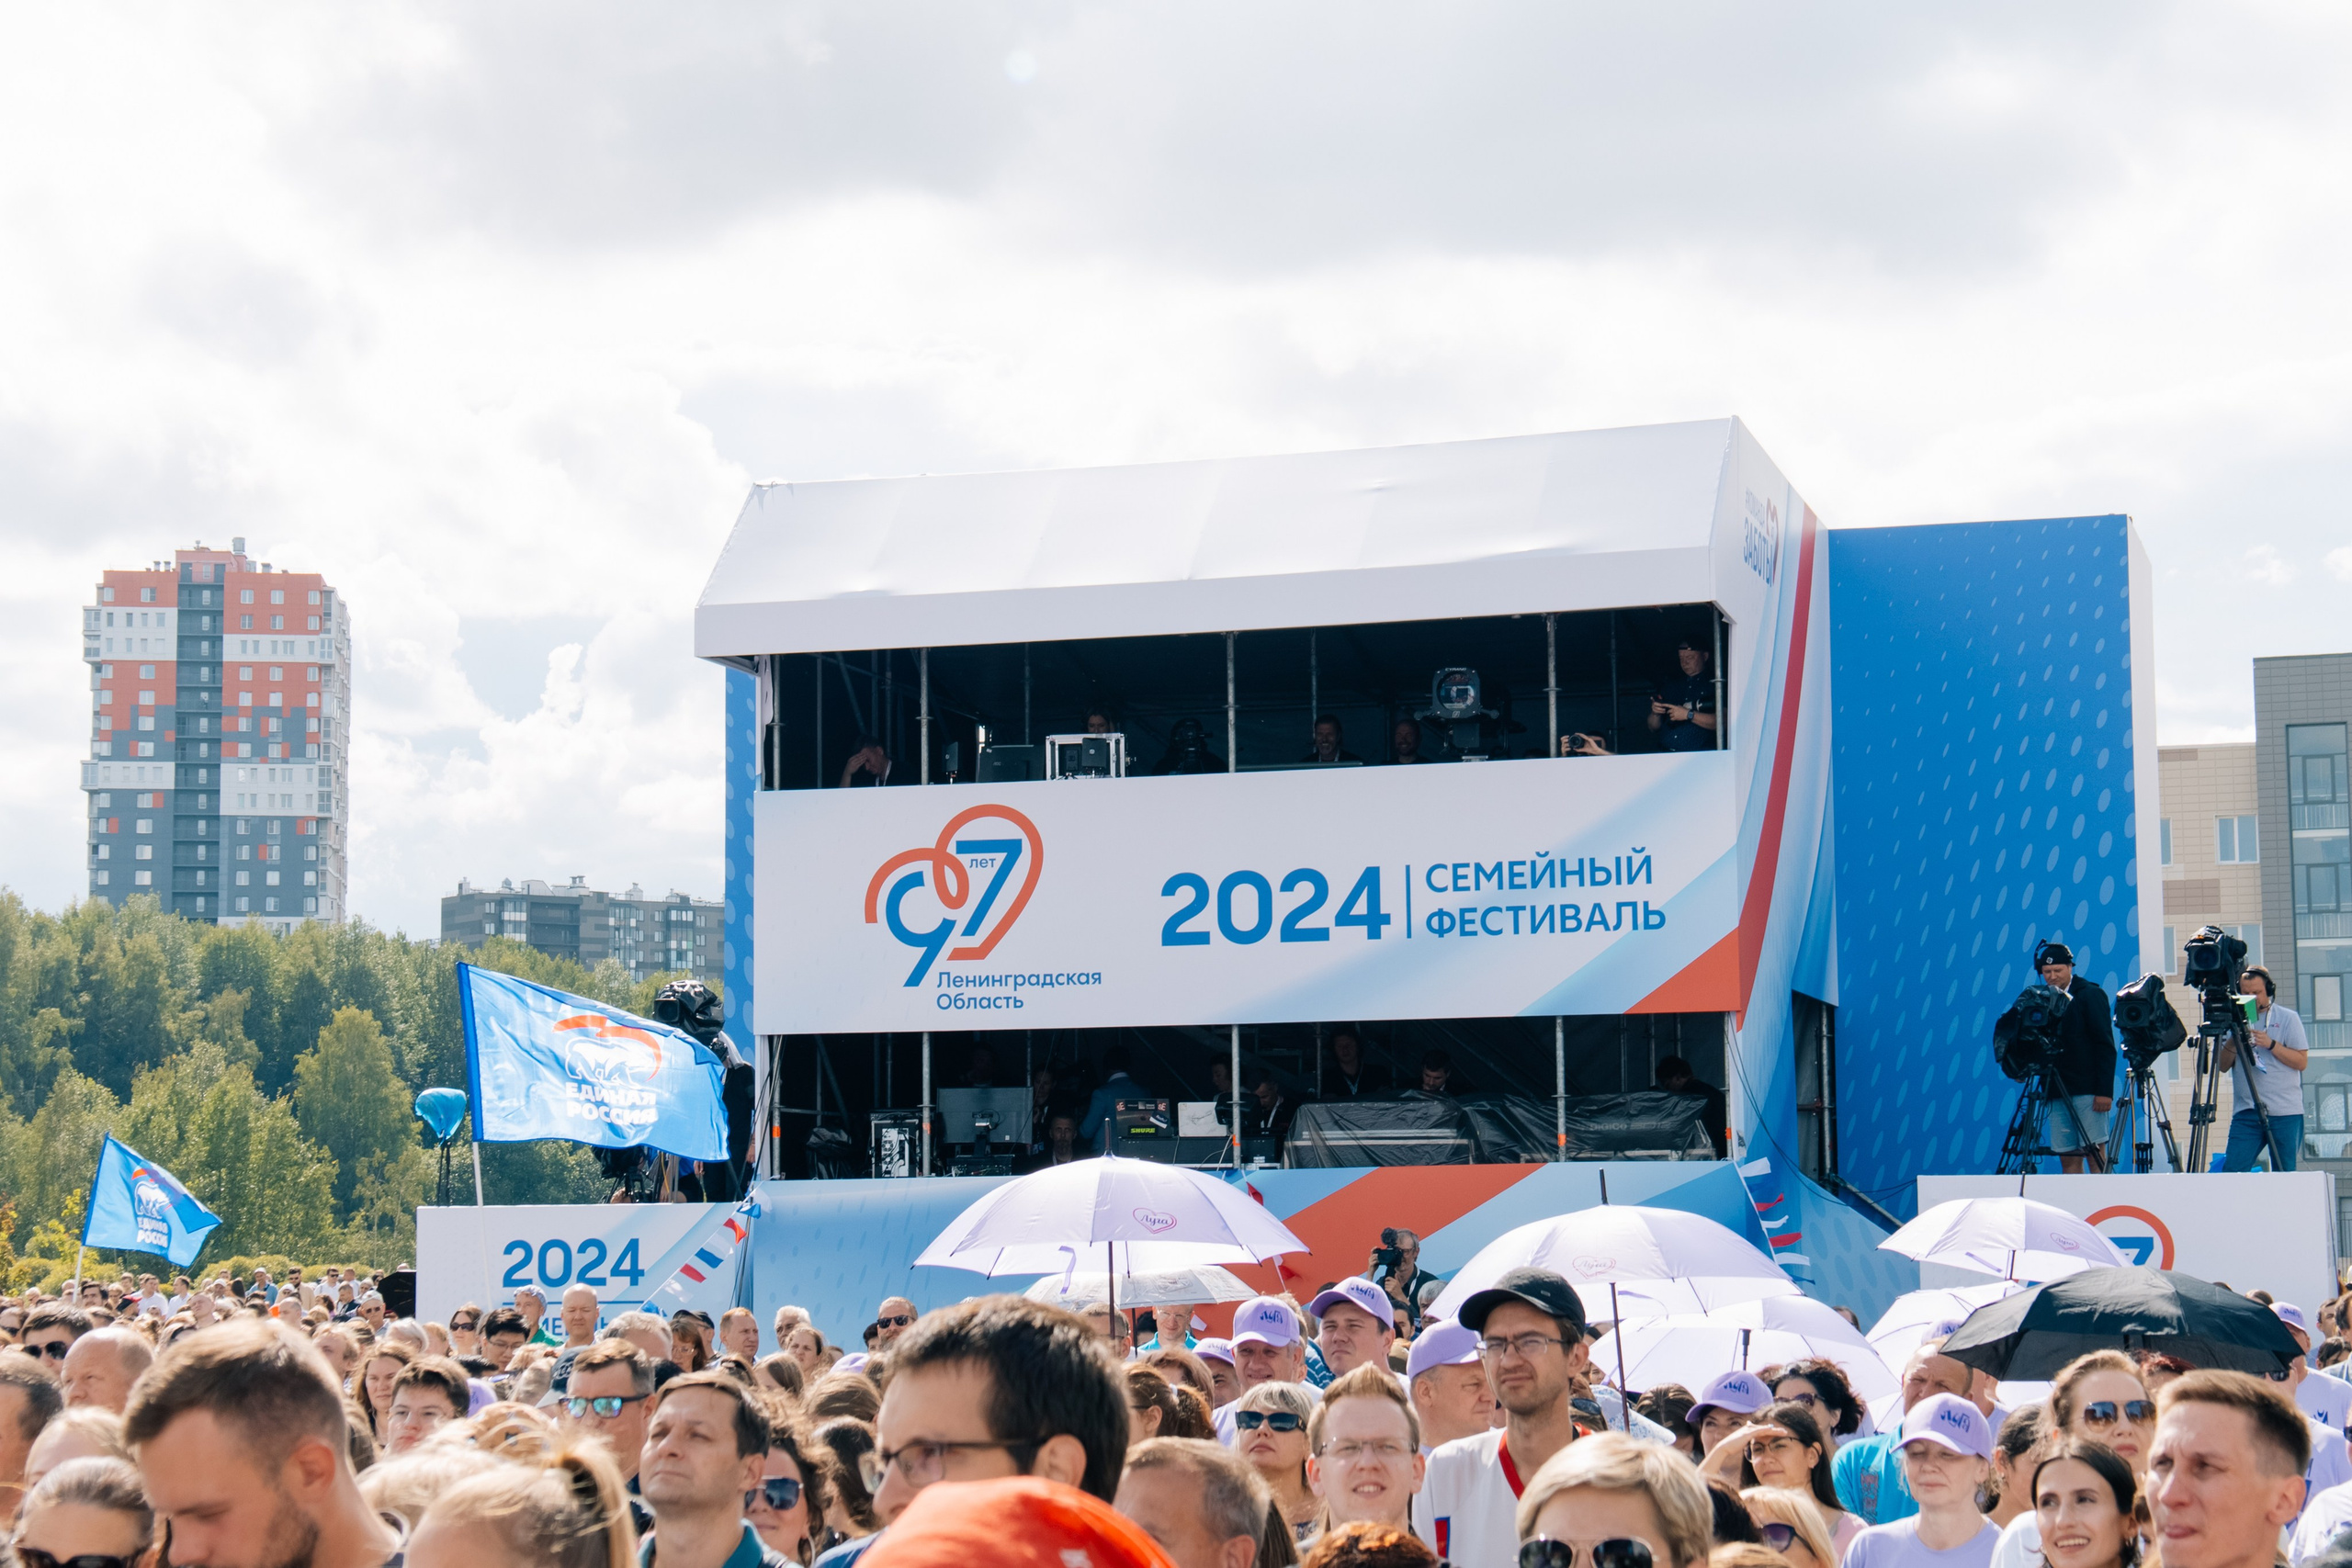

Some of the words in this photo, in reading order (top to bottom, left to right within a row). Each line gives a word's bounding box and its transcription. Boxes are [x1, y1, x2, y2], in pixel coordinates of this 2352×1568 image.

[969, 858, 997, 868] лет
[1425, 846, 1653, 893] СЕМЕЙНЫЙ
[1160, 865, 1391, 946] 2024
[1425, 900, 1667, 939] ФЕСТИВАЛЬ
[936, 970, 1102, 992] Ленинградская
[936, 993, 1024, 1010] Область
[503, 1237, 645, 1288] 2024
